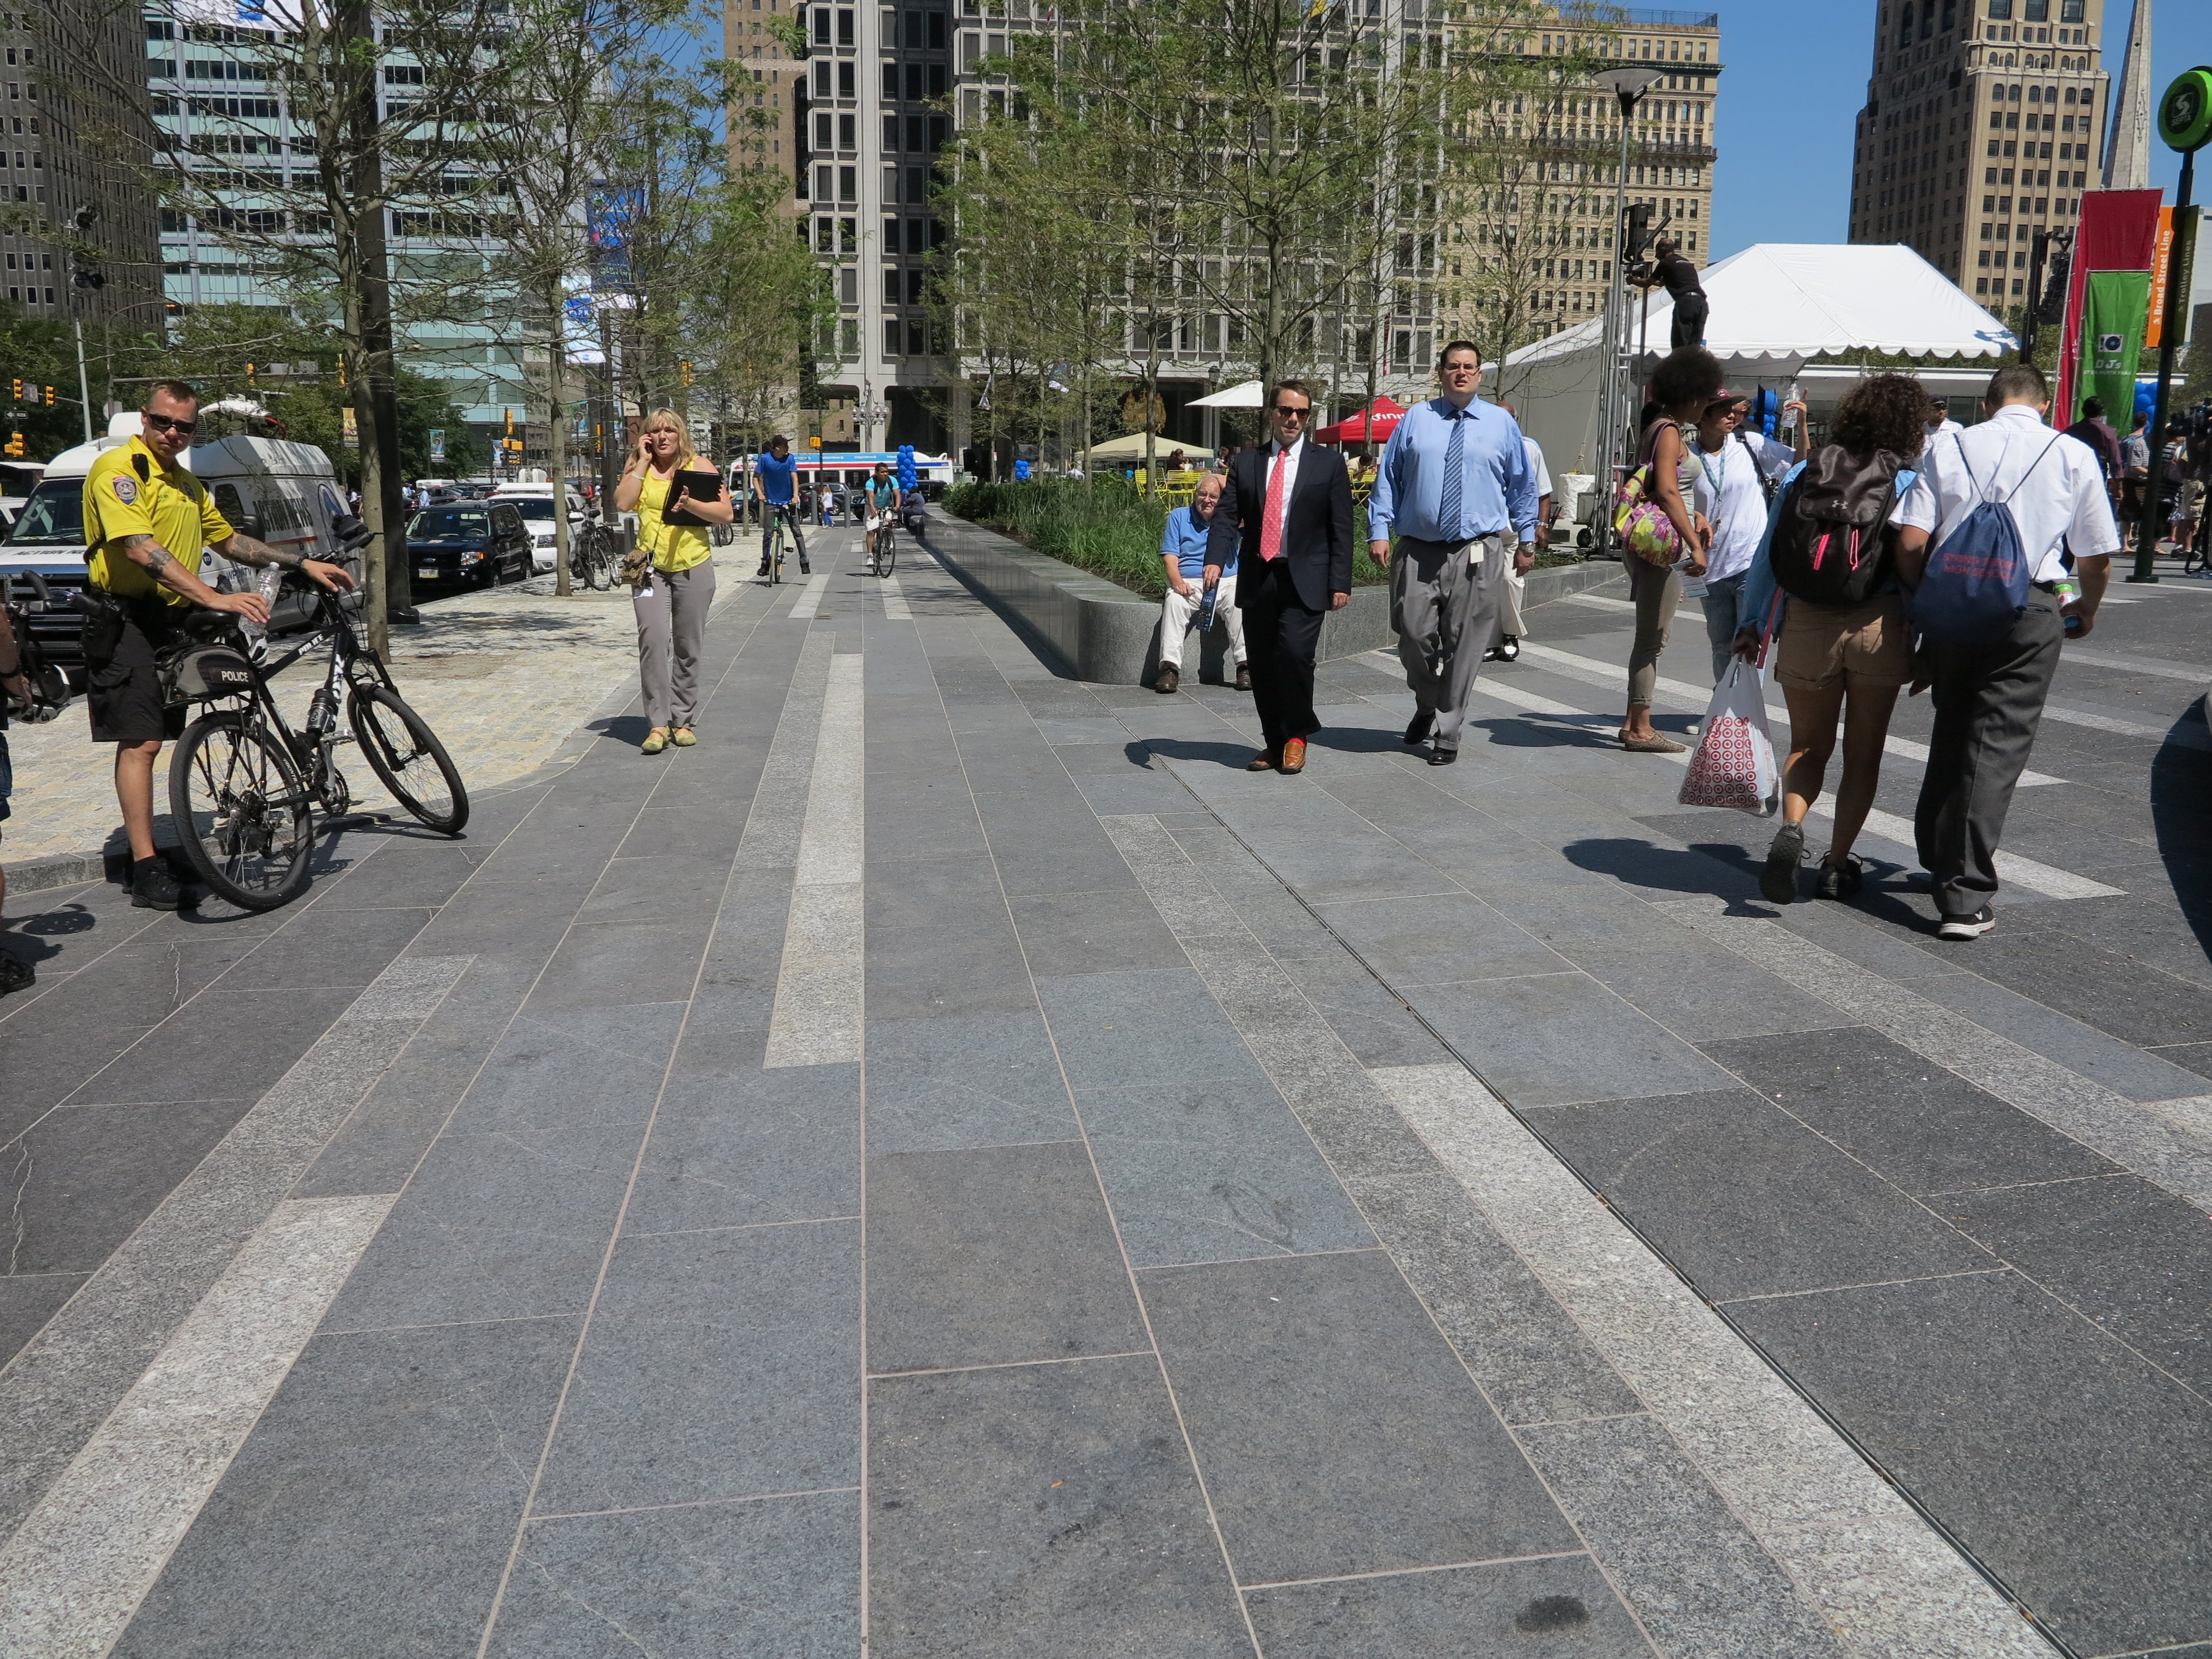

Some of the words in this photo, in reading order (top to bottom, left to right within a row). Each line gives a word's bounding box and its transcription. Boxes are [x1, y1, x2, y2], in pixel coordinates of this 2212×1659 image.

[2171, 114, 2192, 126] SEPTA
[2160, 230, 2170, 251] Line
[2183, 239, 2192, 265] Lines
[2157, 253, 2168, 284] Street
[2178, 268, 2190, 303] Trolley
[2153, 286, 2164, 315] Broad
[2095, 359, 2122, 369] DJs
[1371, 413, 1405, 421] xfini
[253, 499, 289, 533] ACTION
[284, 497, 314, 529] NEWS
[1943, 553, 1980, 565] STRING
[298, 633, 324, 656] POLICE
[221, 670, 249, 682] POLICE
